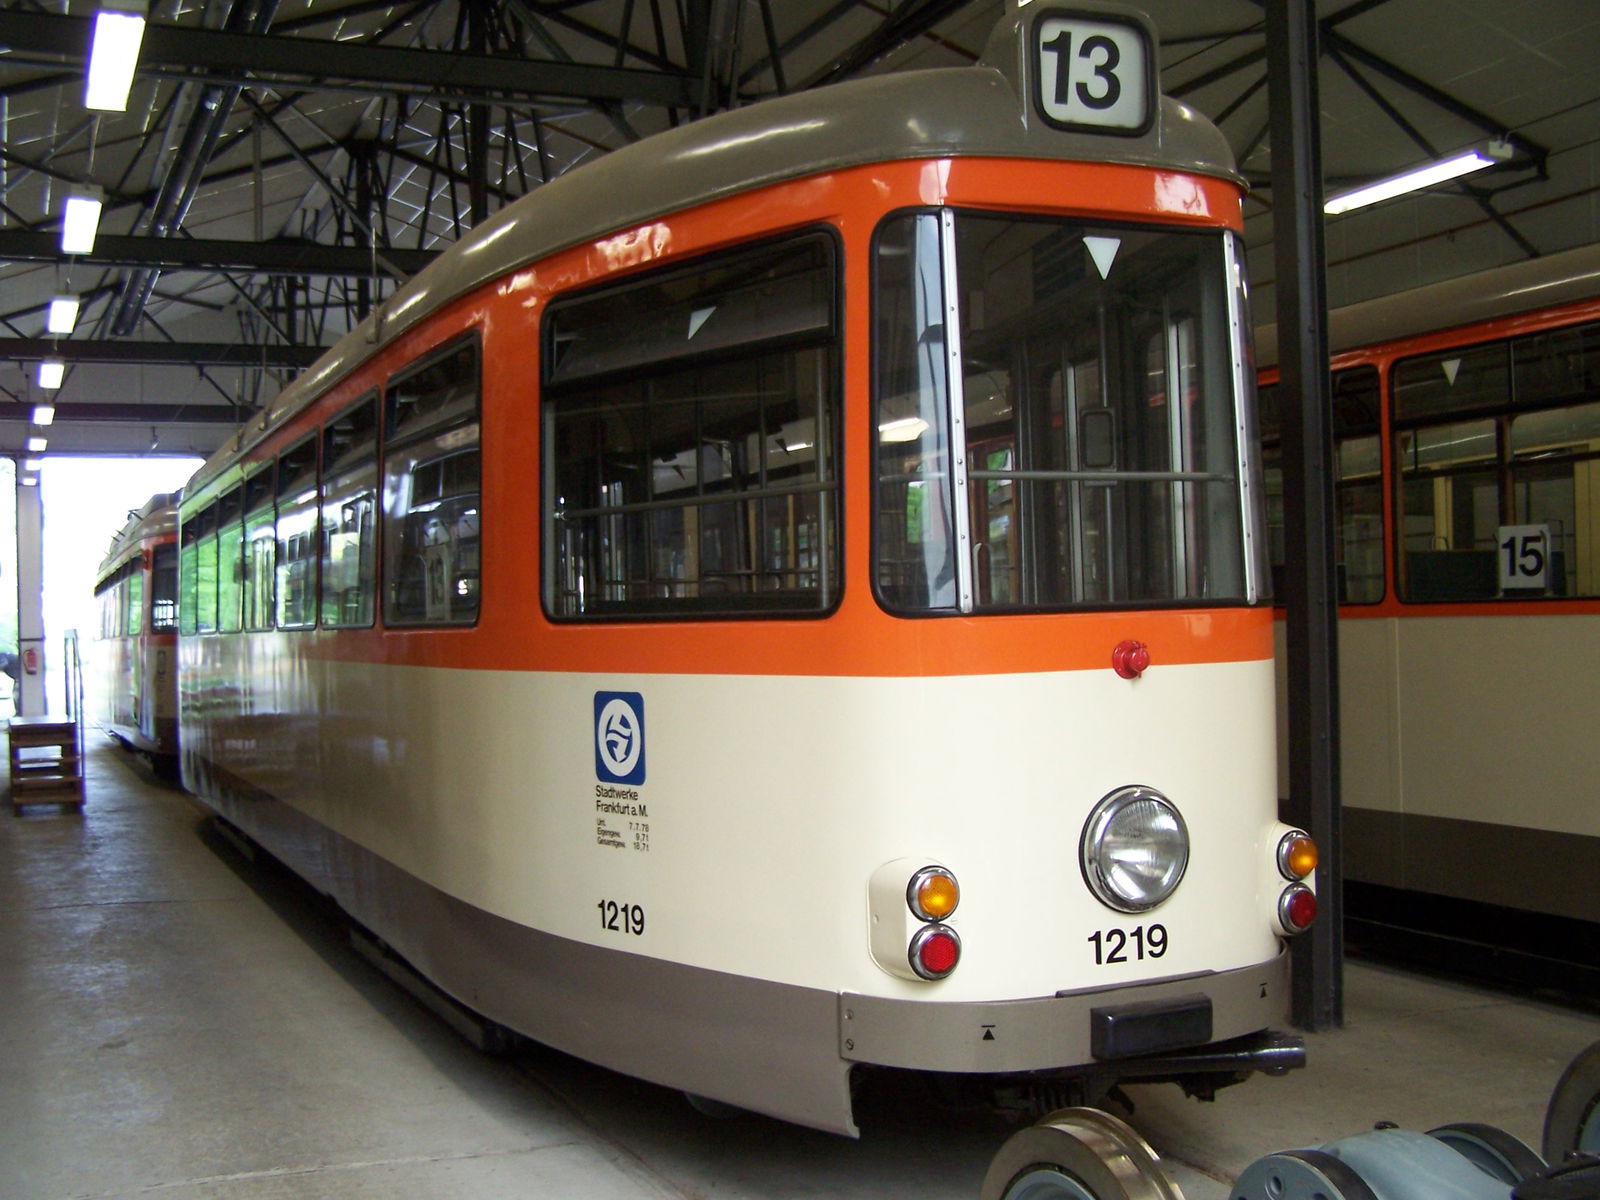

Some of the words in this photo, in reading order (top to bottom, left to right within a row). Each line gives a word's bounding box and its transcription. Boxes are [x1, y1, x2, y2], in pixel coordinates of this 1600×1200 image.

[1041, 30, 1121, 110] 13
[1501, 536, 1544, 577] 15
[596, 785, 639, 801] Stadtwerke
[596, 800, 630, 815] Frankfurt
[598, 899, 645, 936] 1219
[1087, 923, 1169, 965] 1219
